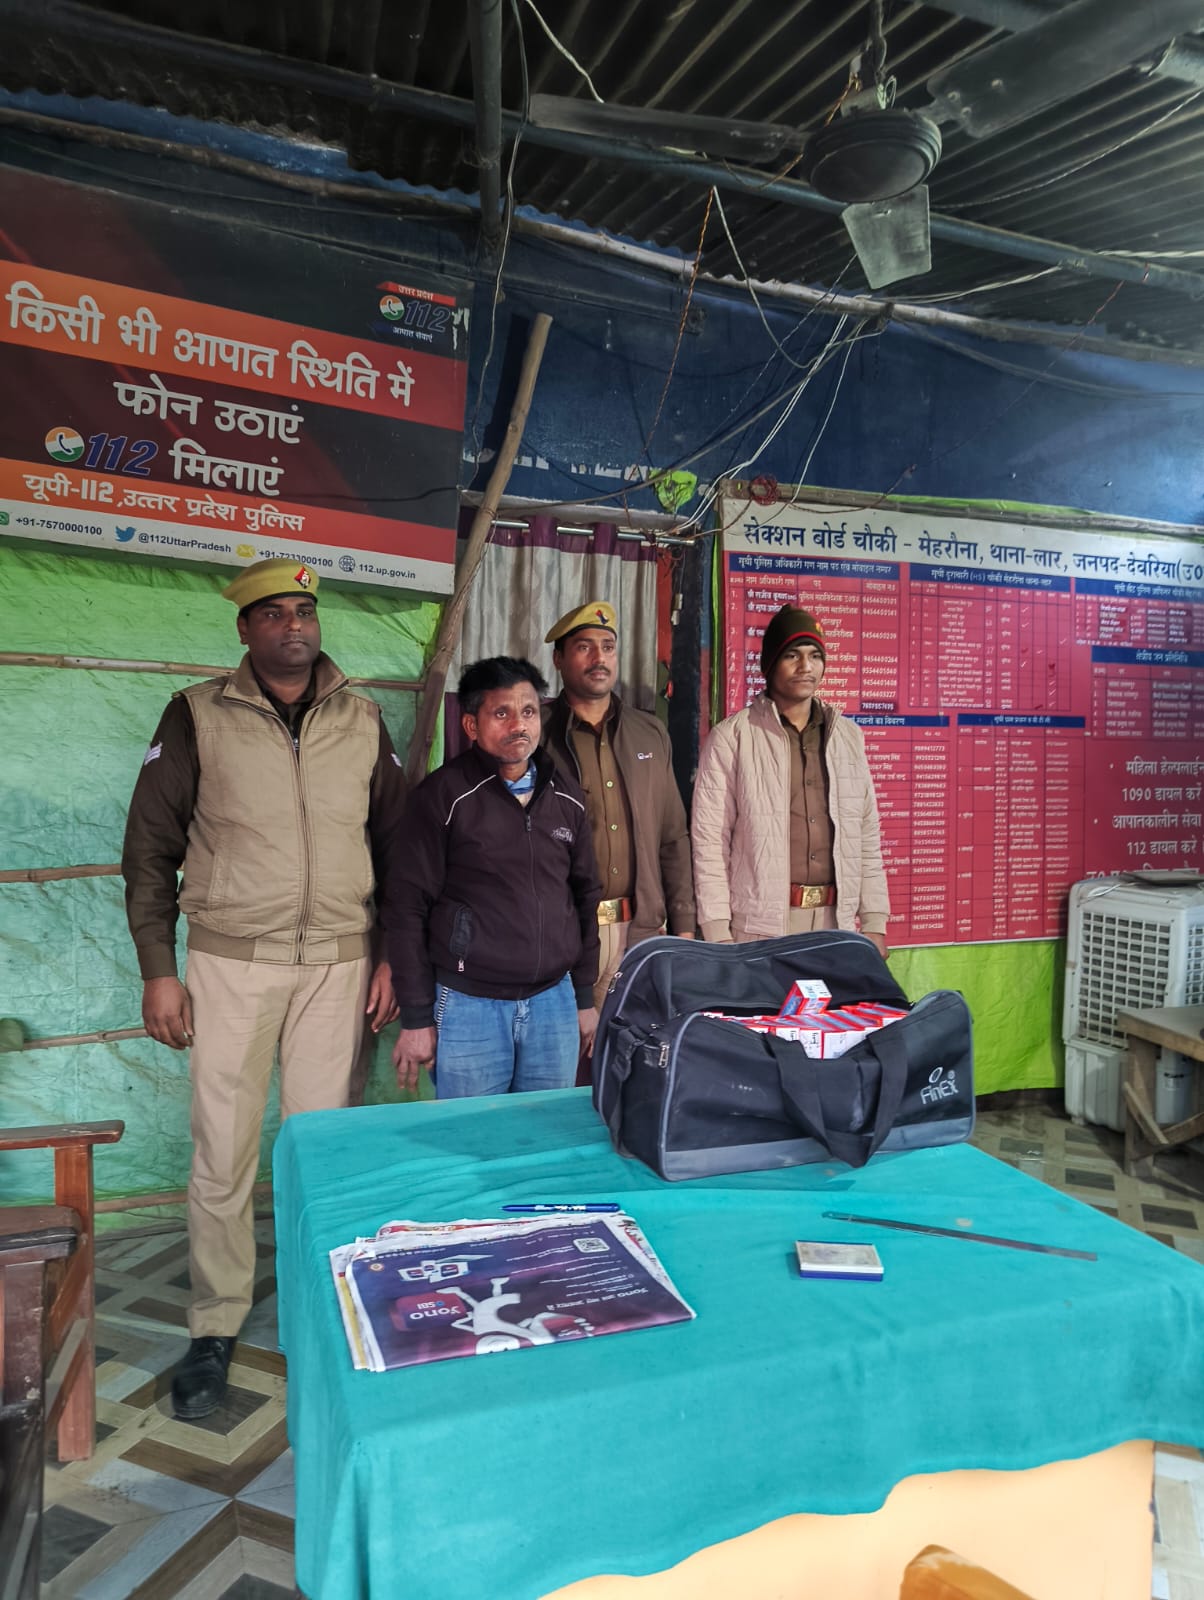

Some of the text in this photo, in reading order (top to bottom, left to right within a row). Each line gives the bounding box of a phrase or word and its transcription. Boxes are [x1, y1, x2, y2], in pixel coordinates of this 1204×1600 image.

[416, 288, 434, 301] प्रदेश
[404, 300, 451, 333] 112
[5, 280, 415, 407] किसी भी आपात स्थिति में
[112, 373, 305, 444] फोन उठाएं
[84, 432, 159, 477] 112
[168, 437, 285, 497] मिलाएं
[185, 494, 238, 522] प्रदेश
[243, 504, 306, 532] पुलिस
[15, 517, 103, 536] +91-7570000100
[138, 532, 232, 554] @112UttarPradesh
[744, 516, 806, 547] सेक्शन
[812, 521, 848, 549] बोर्ड
[852, 523, 898, 554] चौकी
[918, 530, 984, 565] मेहरौना,
[358, 563, 417, 581] 112.up.gov.in
[1126, 755, 1158, 775] महिला
[1122, 787, 1152, 802] 1090
[1154, 787, 1182, 801] डायल
[1112, 808, 1202, 830] आपातकालीन सेवा
[1127, 841, 1147, 856] 112
[1150, 839, 1178, 855] डायल
